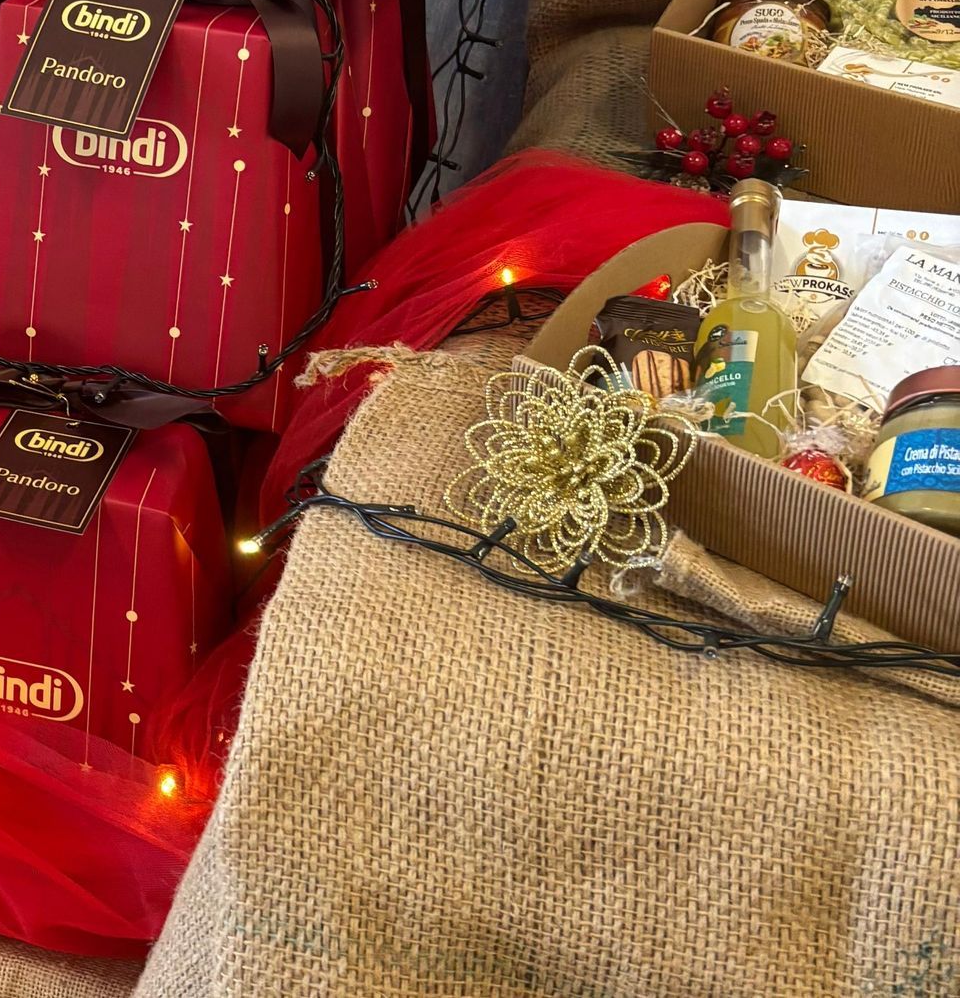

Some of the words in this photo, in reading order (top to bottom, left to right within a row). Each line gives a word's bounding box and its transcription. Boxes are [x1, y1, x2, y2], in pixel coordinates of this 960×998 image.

[74, 4, 139, 36] bindi
[754, 8, 784, 17] SUGO
[40, 56, 126, 89] Pandoro
[101, 164, 131, 176] 1946
[906, 253, 926, 269] LA
[888, 278, 946, 308] PISTACCHIO
[27, 431, 92, 458] bindi
[904, 447, 929, 462] Crema
[929, 444, 938, 459] di
[901, 467, 913, 477] con
[913, 462, 946, 475] Pistacchio
